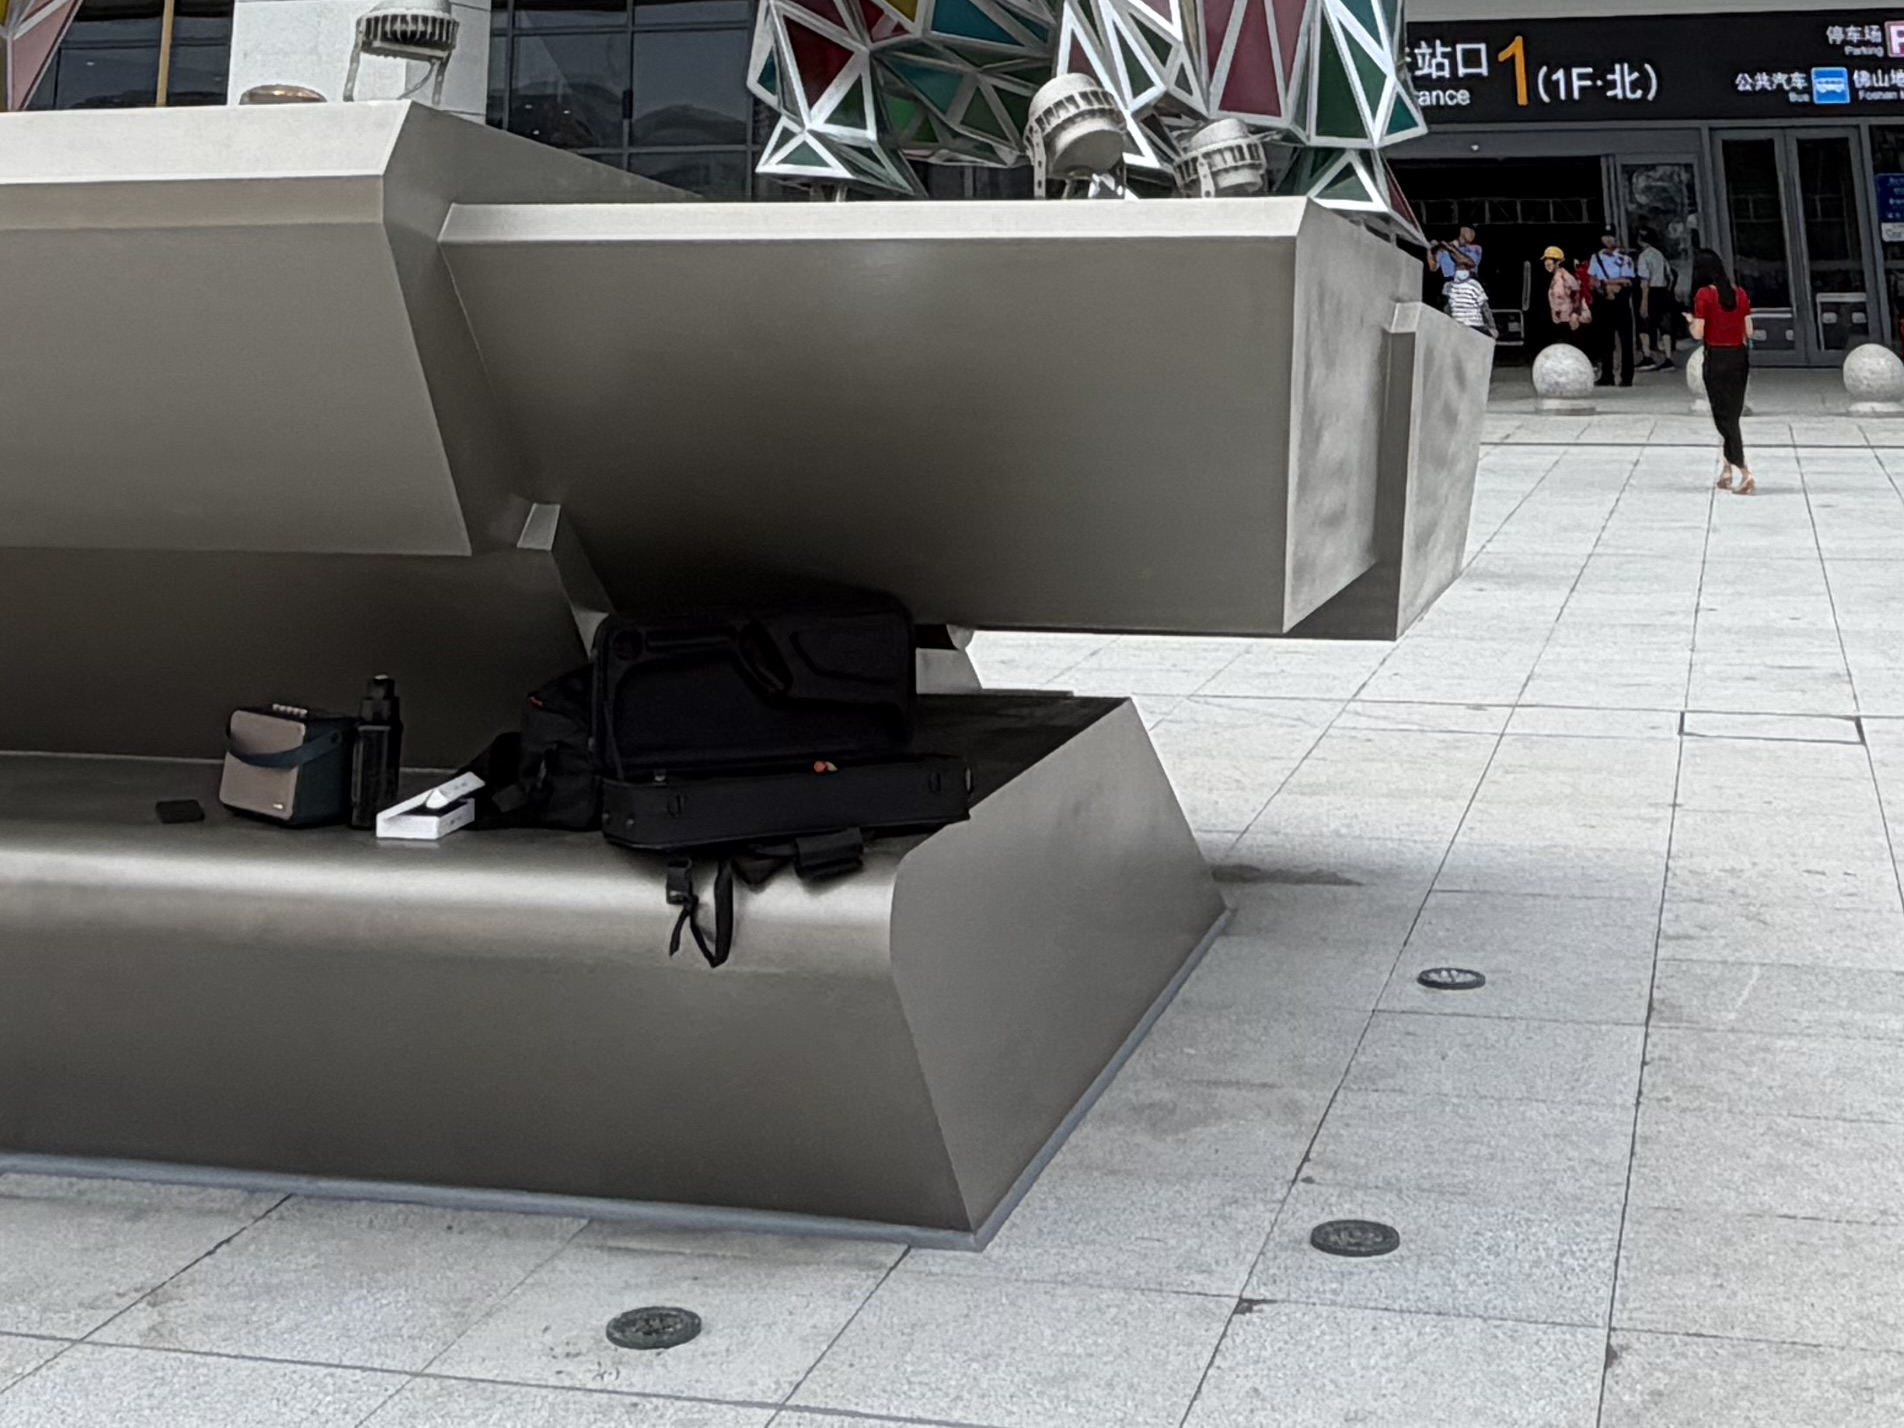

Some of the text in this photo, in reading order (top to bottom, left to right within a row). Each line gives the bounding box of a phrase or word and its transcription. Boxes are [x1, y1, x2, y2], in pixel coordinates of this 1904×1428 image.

[1826, 25, 1882, 44] 停车场
[1844, 46, 1884, 57] Parking
[1405, 39, 1489, 79] 站口
[1498, 35, 1528, 106] 1
[1735, 72, 1808, 91] 公共汽车
[1418, 88, 1471, 106] ance
